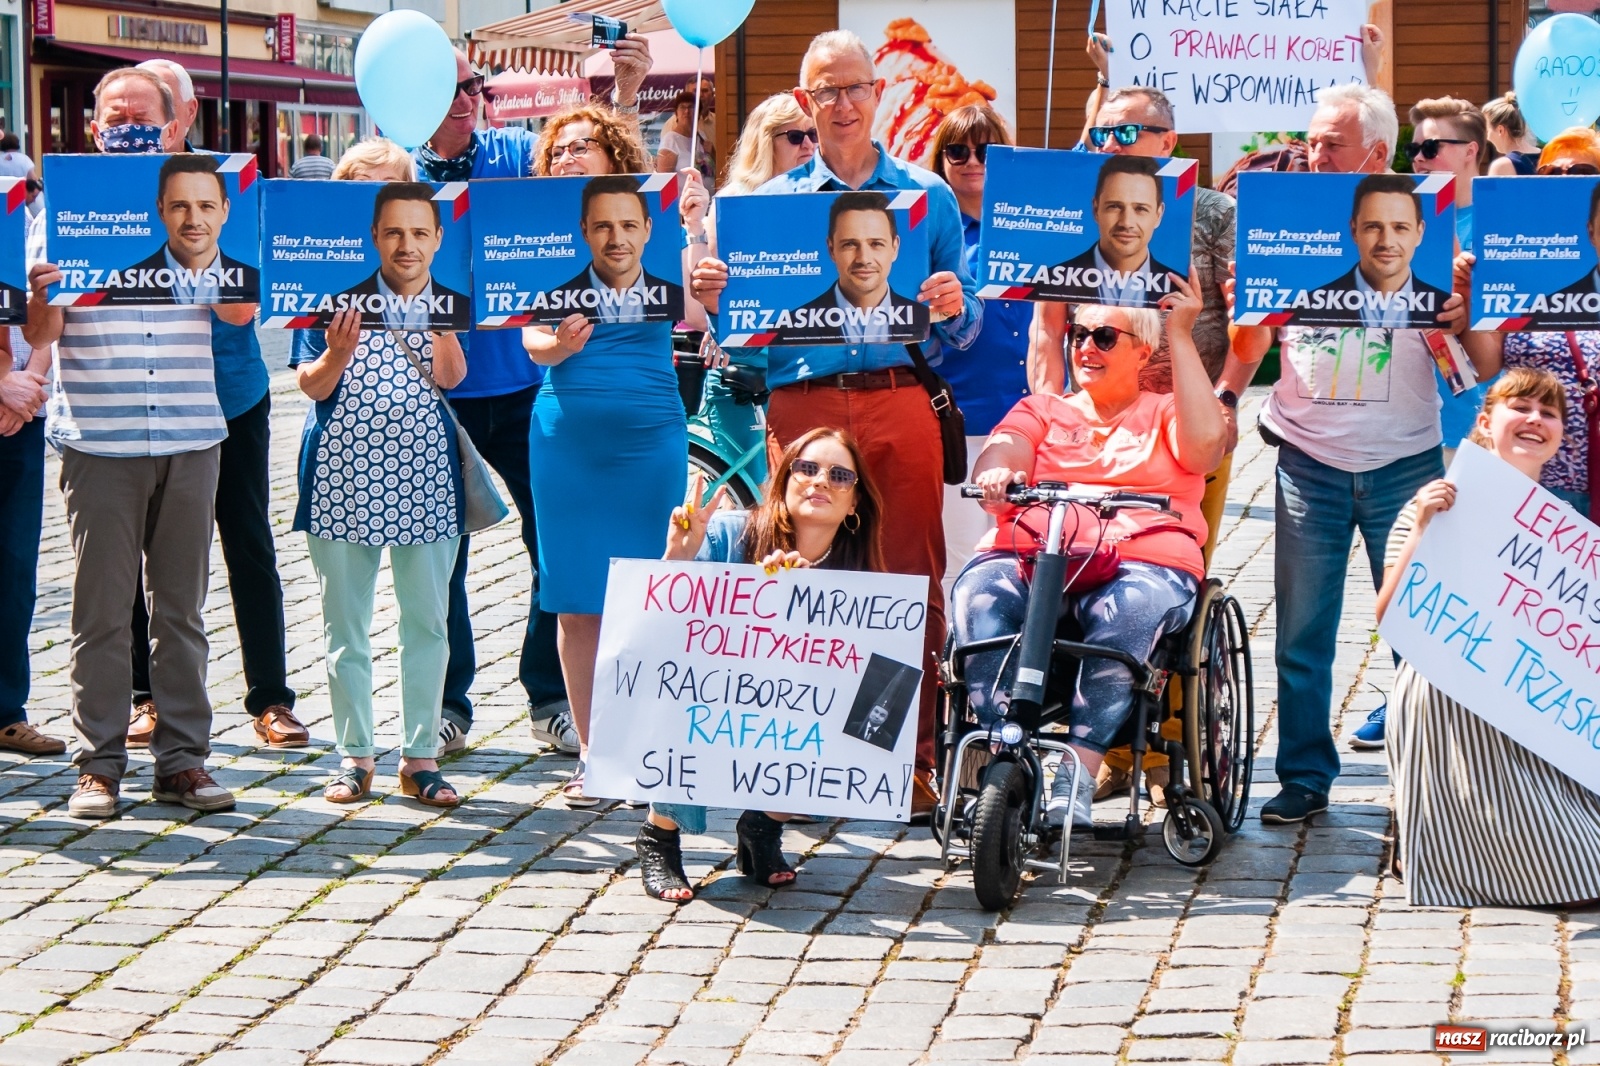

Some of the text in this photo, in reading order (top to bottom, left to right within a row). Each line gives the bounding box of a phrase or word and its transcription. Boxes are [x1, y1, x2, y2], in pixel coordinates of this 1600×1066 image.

[281, 16, 291, 57] ŻYWIEC
[1130, 29, 1364, 63] O PRAWACH KOBIET
[1535, 55, 1600, 78] RADO
[493, 87, 585, 116] Gelateria Ciao Italia
[57, 210, 149, 224] Silny Prezydent
[994, 202, 1083, 220] Silny Prezydent
[57, 223, 152, 238] Wspólna Polska
[992, 217, 1084, 234] Wspólna Polska
[272, 235, 363, 249] Silny Prezydent
[484, 232, 573, 248] Silny Prezydent
[1248, 229, 1341, 242] Silny Prezydent
[1484, 233, 1578, 247] Silny Prezydent
[272, 249, 365, 263] Wspólna Polska
[485, 245, 576, 262] Wspólna Polska
[728, 250, 819, 265] Silny Prezydent
[989, 250, 1020, 260] RAFAŁ
[1247, 243, 1343, 257] Wspólna Polska
[1483, 247, 1581, 261] Wspólna Polska
[57, 259, 90, 268] RAFAŁ
[729, 263, 822, 279] Wspólna Polska
[60, 267, 245, 289] TRZASKOWSKI
[987, 261, 1171, 293] TRZASKOWSKI
[1246, 278, 1278, 287] RAFAŁ
[271, 282, 303, 291] RAFAŁ
[486, 282, 517, 291] RAFAŁ
[1483, 283, 1516, 292] RAFAŁ
[271, 292, 454, 315] TRZASKOWSKI
[485, 286, 668, 313] TRZASKOWSKI
[729, 299, 760, 309] RAFAŁ
[1245, 289, 1435, 312] TRZASKOWSKI
[729, 306, 914, 331] TRZASKOWSKI
[1497, 533, 1543, 581] NA
[644, 571, 925, 632] KONIEC MARNEGO
[1397, 562, 1493, 674] RAFAŁ
[1497, 572, 1600, 674] TROSK
[685, 619, 864, 674] POLITYKIERA
[615, 659, 836, 716] W RACIBORZU
[685, 705, 825, 757] RAFAŁA
[635, 748, 697, 800] SIĘ
